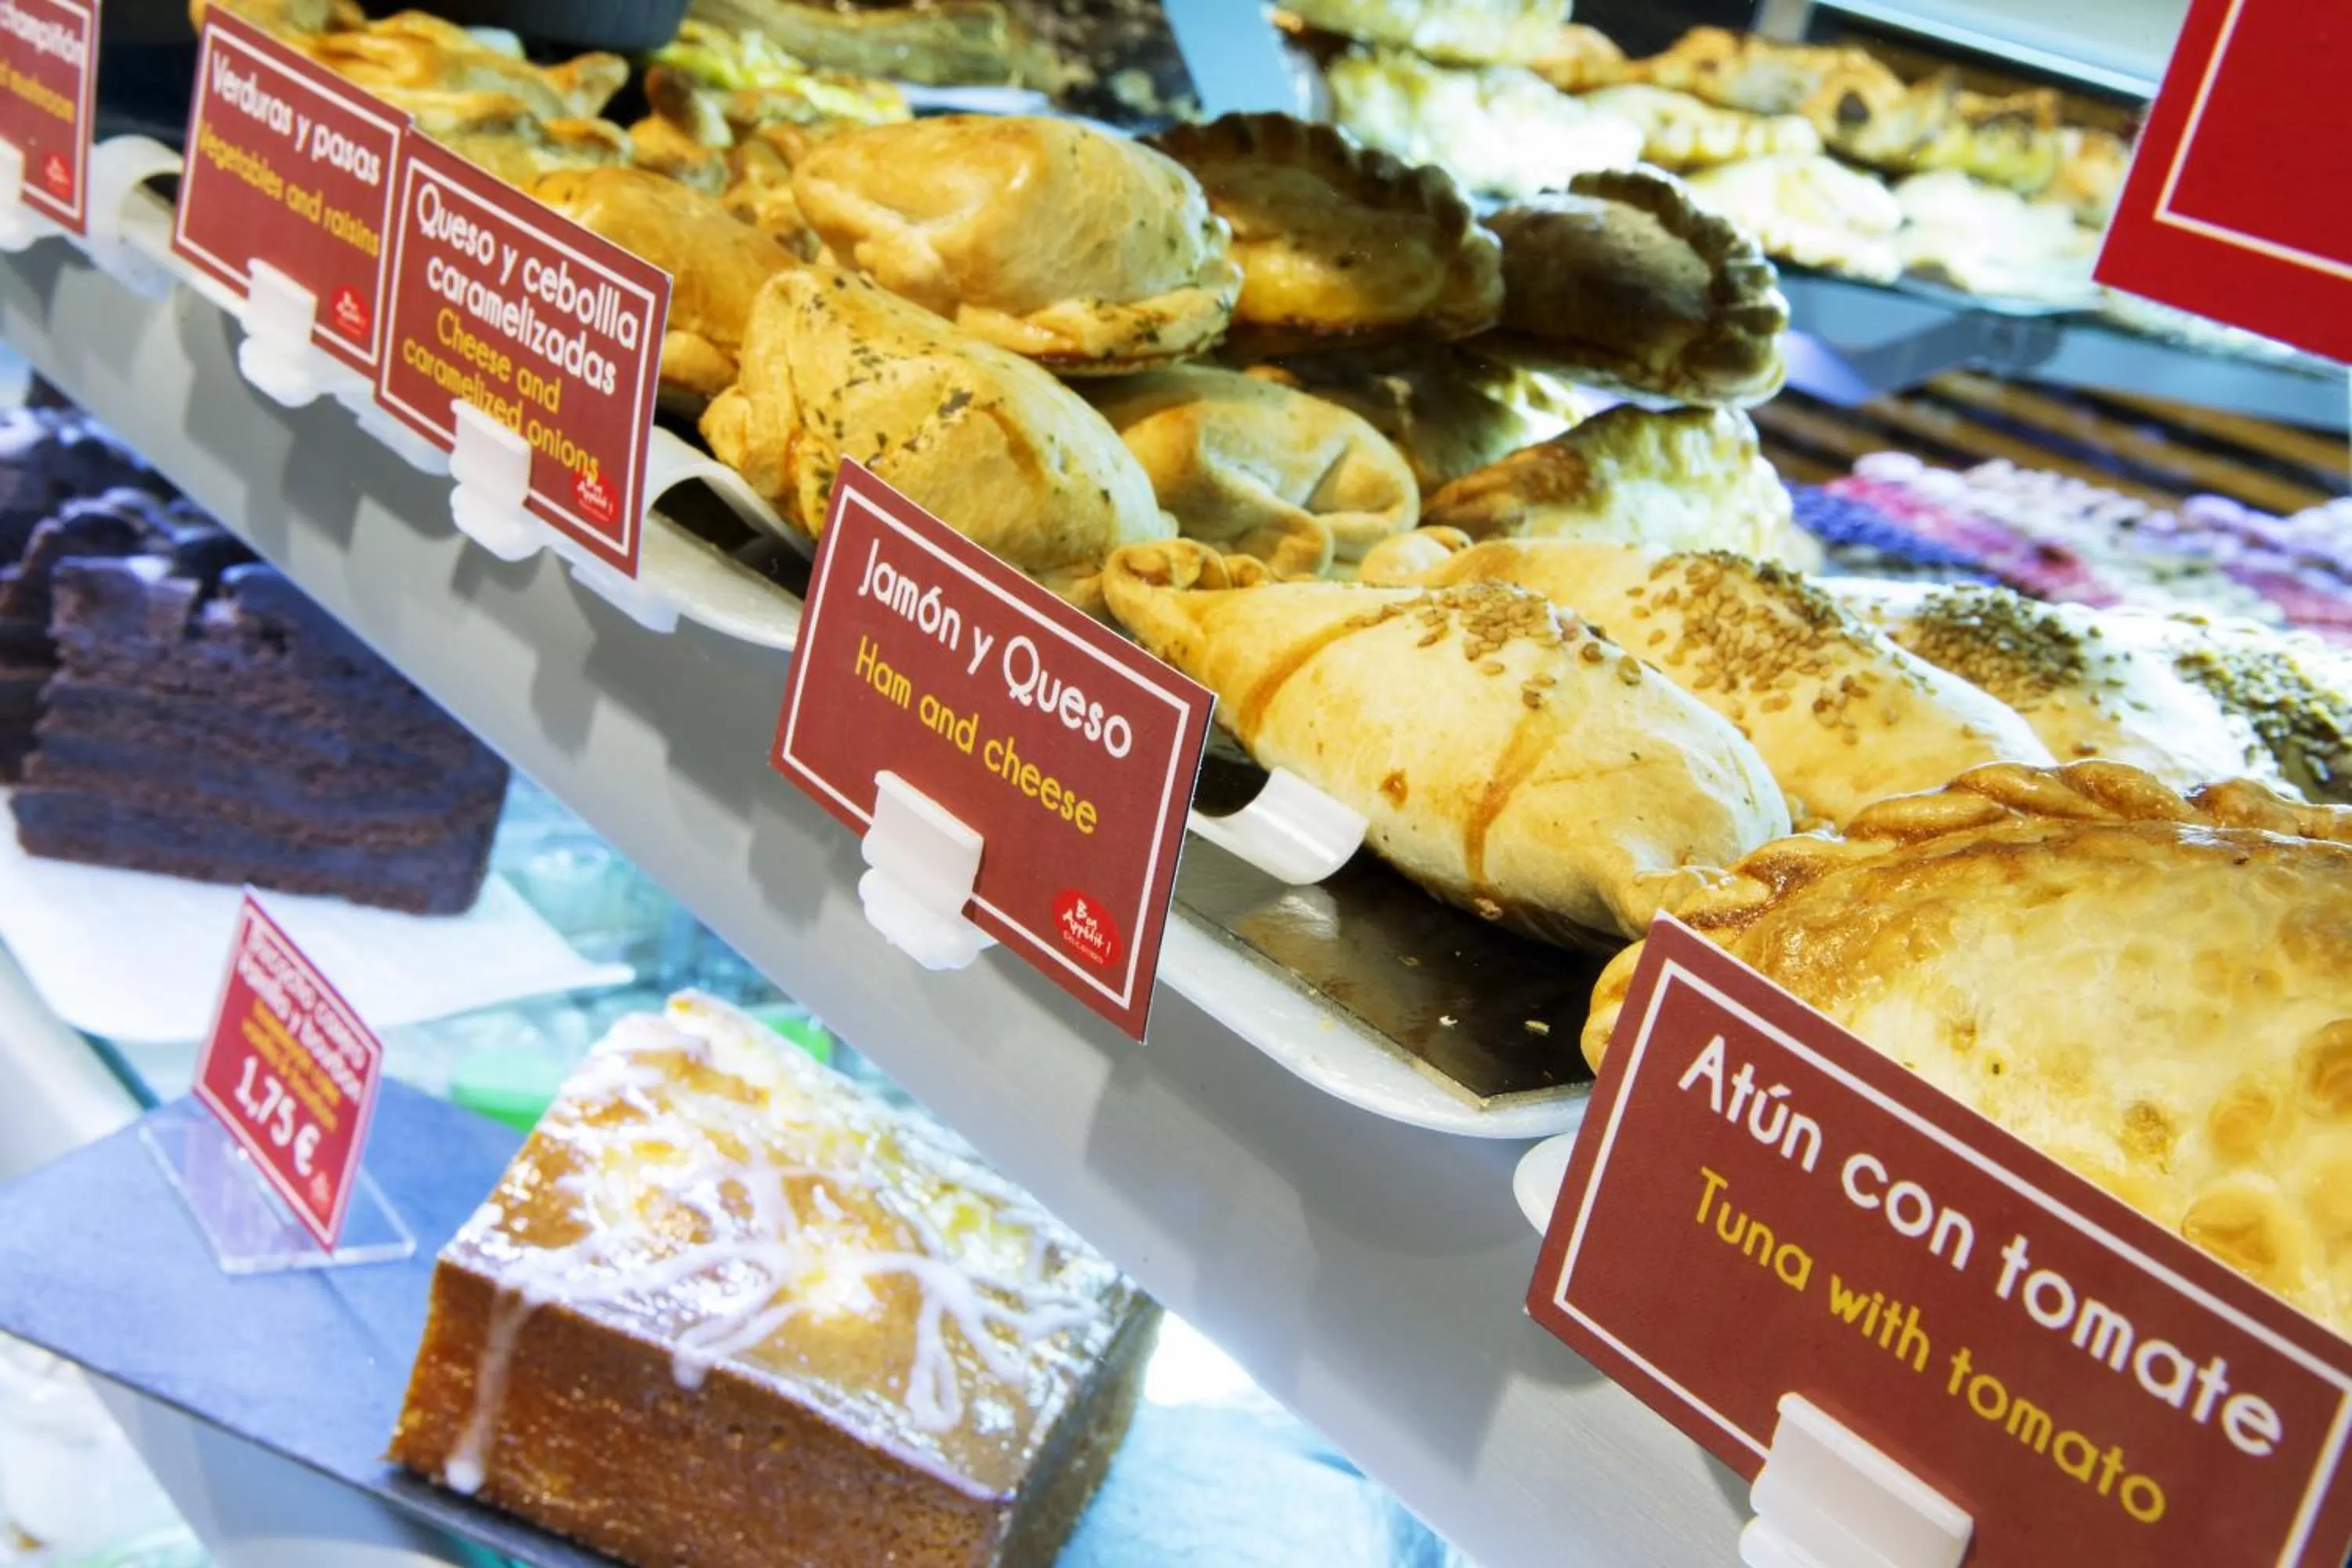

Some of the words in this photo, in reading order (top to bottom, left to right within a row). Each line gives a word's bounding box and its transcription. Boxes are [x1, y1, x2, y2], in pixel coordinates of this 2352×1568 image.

[212, 49, 294, 136] Verduras
[296, 113, 313, 153] y
[314, 124, 380, 187] pasas
[198, 122, 284, 203] Vegetables
[285, 182, 322, 224] and
[324, 210, 380, 259] raisins
[416, 182, 495, 267] Queso
[499, 244, 519, 285] y
[426, 255, 616, 396] caramelizadas
[436, 307, 513, 383] Cheese
[516, 366, 562, 415] and
[401, 336, 524, 436] caramelized
[527, 419, 599, 485] onions
[858, 538, 960, 650] Jamón
[967, 633, 994, 675] y
[1002, 635, 1132, 759] Queso
[855, 635, 911, 710] Ham
[919, 694, 979, 756] and
[983, 736, 1098, 835] cheese
[234, 1054, 297, 1149] 1,75
[1676, 1032, 1824, 1173] Atún
[1840, 1152, 1976, 1271] con
[1993, 1235, 2284, 1457] tomate
[1693, 1166, 1815, 1293] Tuna
[1828, 1271, 1932, 1373] with
[1945, 1345, 2168, 1524] tomato
